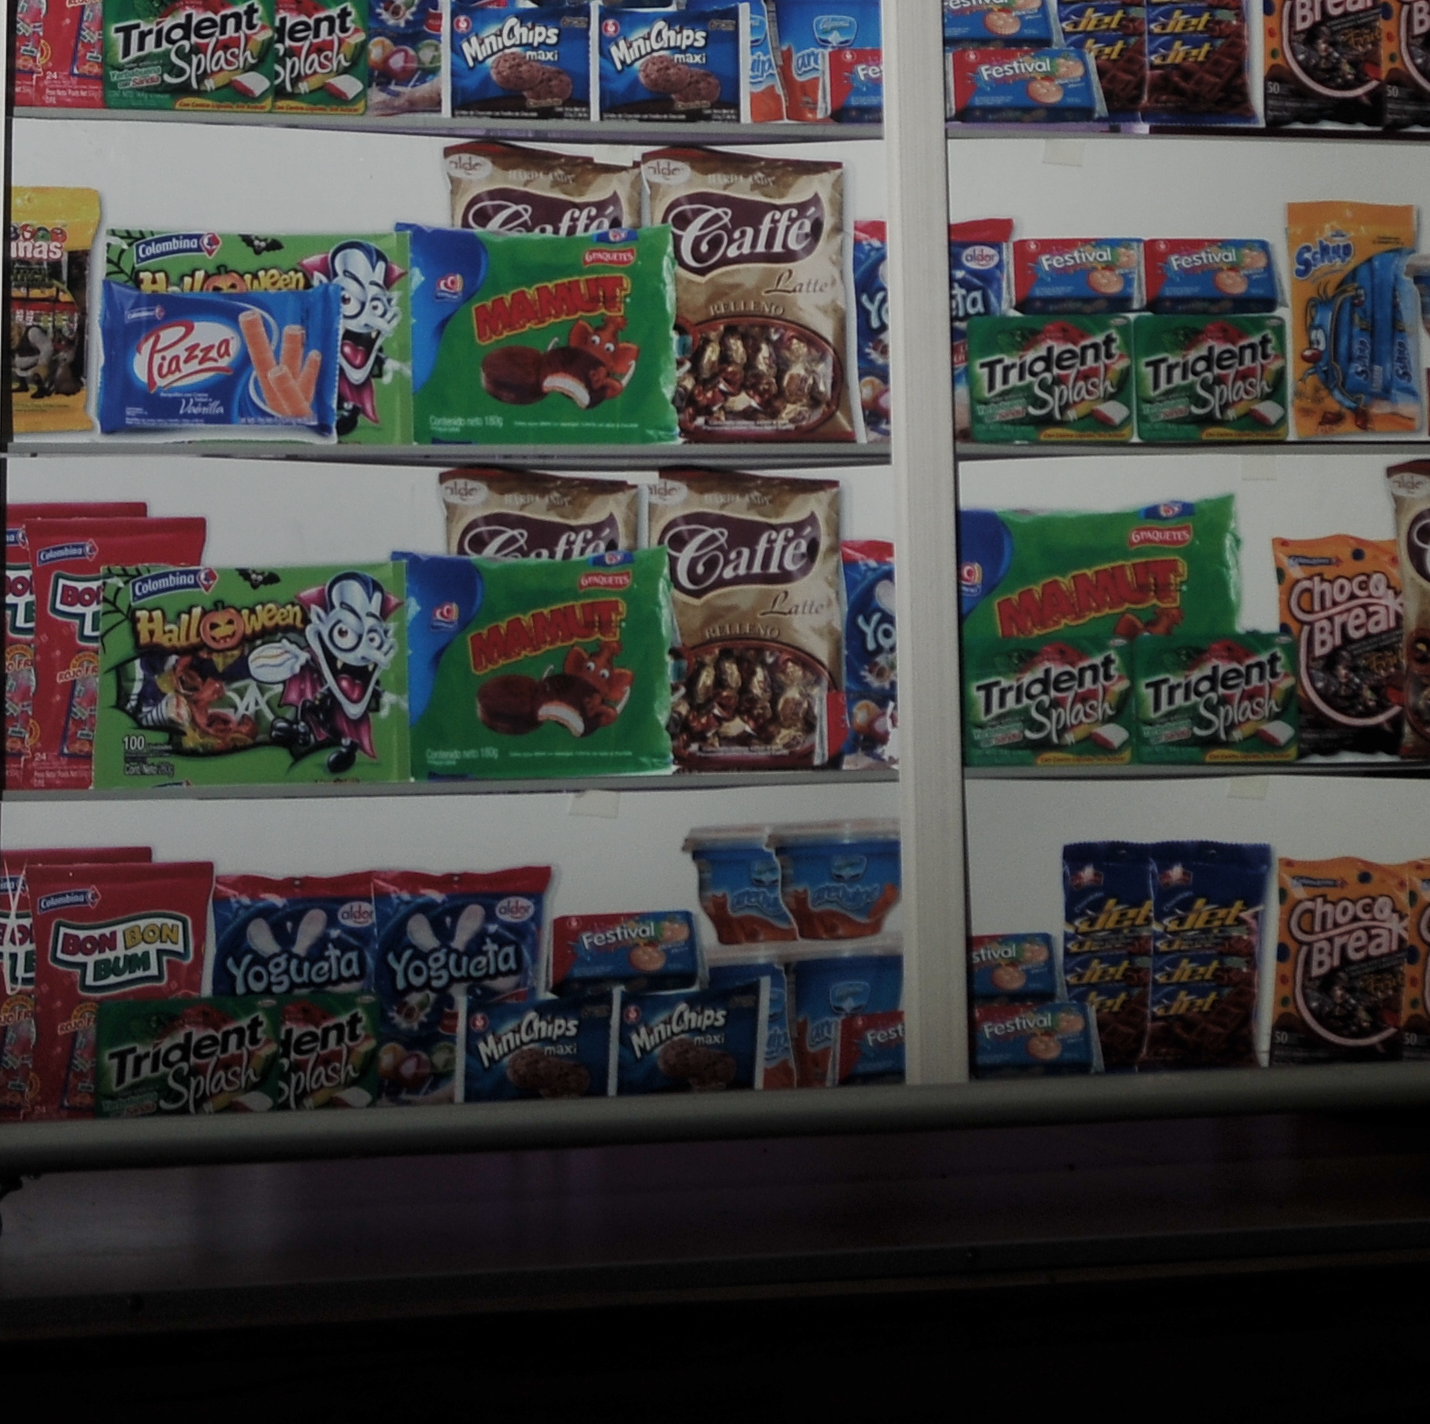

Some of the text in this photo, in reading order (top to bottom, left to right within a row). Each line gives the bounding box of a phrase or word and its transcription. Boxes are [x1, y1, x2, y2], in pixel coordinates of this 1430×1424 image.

[114, 2, 260, 60] Trident
[526, 49, 559, 63] maxi
[165, 41, 258, 91] Splash
[674, 52, 707, 65] maxi
[980, 58, 1051, 80] Festival
[138, 238, 198, 257] Colombina
[671, 203, 816, 269] Caffé
[1040, 248, 1112, 271] Festival
[764, 269, 830, 296] Latte
[475, 276, 628, 343] MAMUT
[709, 303, 785, 316] RELLENO
[136, 320, 233, 393] Piazza
[979, 333, 1116, 397] Trident
[1145, 333, 1272, 395] Trident
[1028, 373, 1116, 421] Splash
[1190, 365, 1272, 421] Splash
[667, 525, 810, 589] Caffé
[134, 572, 195, 596] Colombina
[997, 558, 1187, 638] MAMUT
[471, 599, 625, 674] MAMUT
[976, 654, 1117, 717] Trident
[1024, 688, 1116, 744] Splash
[122, 736, 146, 751] 100
[61, 922, 179, 956] BON BON
[581, 922, 655, 949] Festival
[93, 953, 151, 979] BUM
[108, 1014, 264, 1089] Trident
